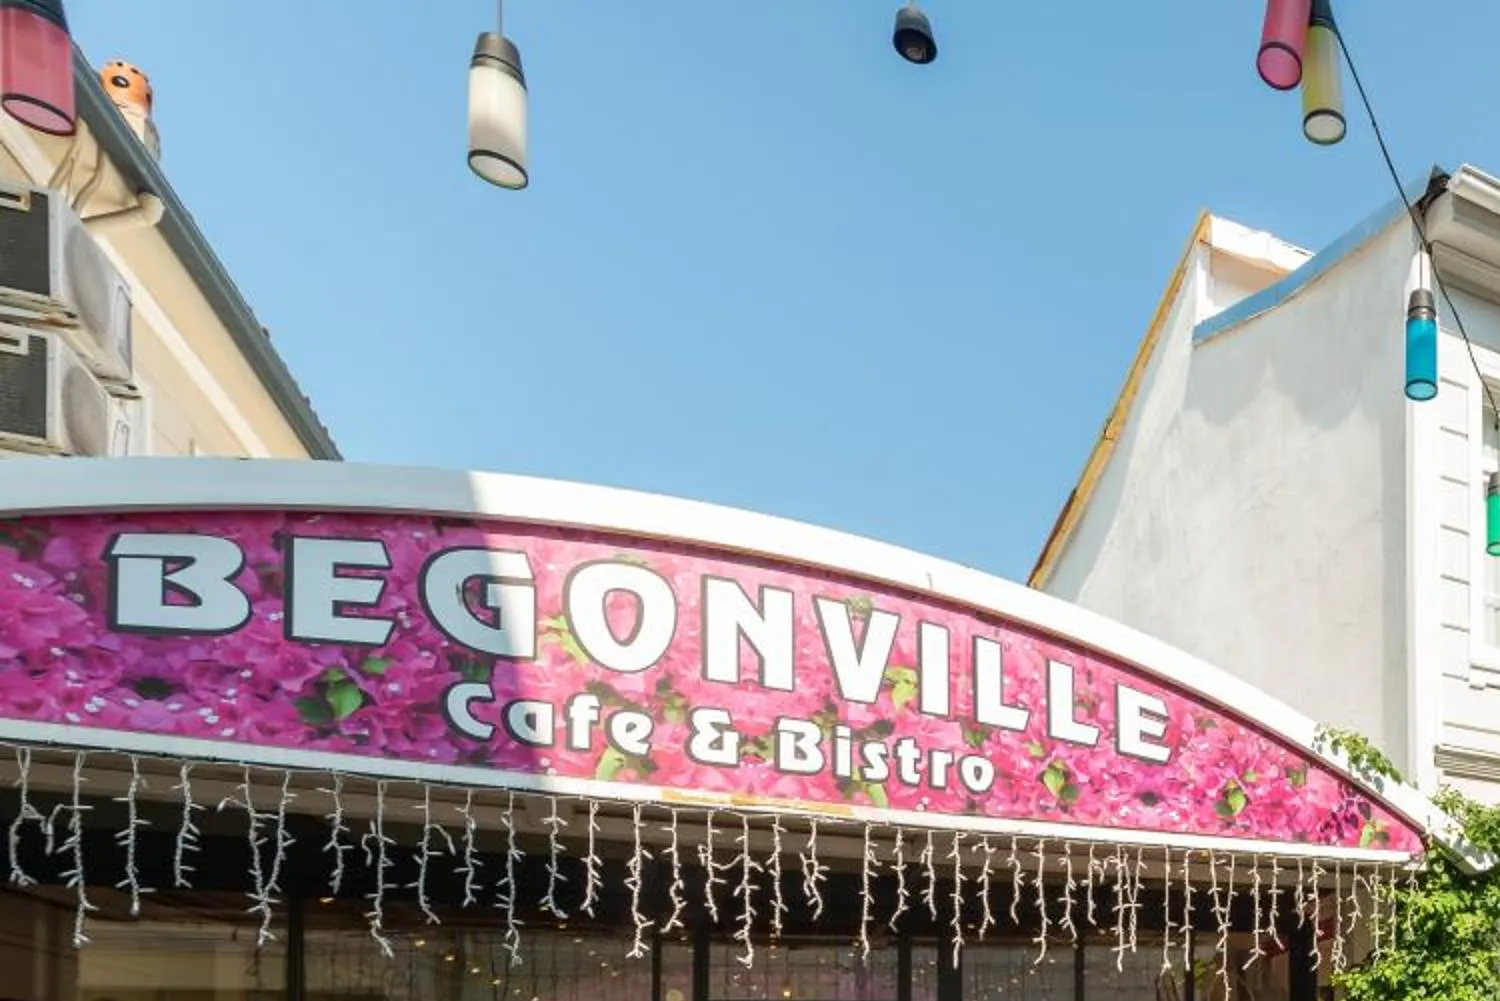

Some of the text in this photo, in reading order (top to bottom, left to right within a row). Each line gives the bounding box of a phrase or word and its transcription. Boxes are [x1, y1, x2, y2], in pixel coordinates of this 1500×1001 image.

[106, 532, 1174, 764] BEGONVILLE
[441, 679, 995, 796] Cafe & Bistro
